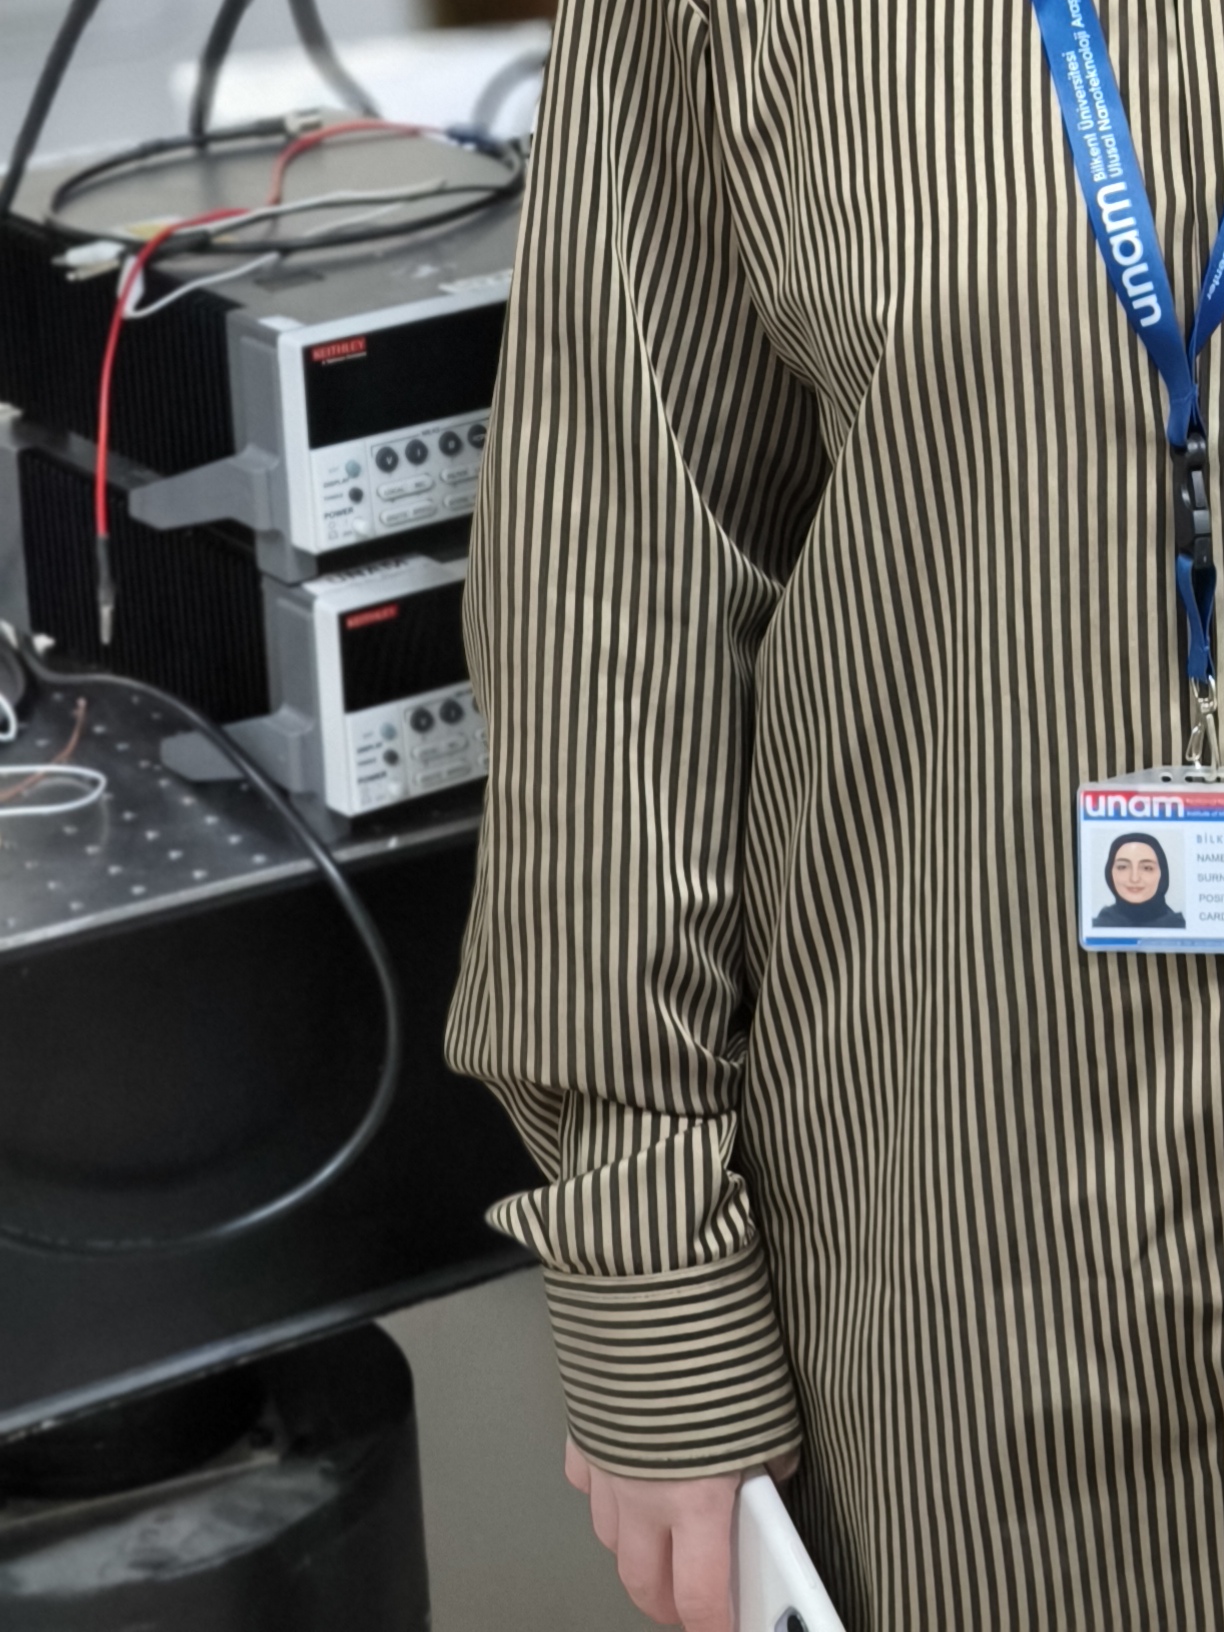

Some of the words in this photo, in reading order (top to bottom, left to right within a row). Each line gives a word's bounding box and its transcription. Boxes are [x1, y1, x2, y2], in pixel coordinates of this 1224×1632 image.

[1061, 50, 1094, 131] Üniversitesi
[1073, 30, 1112, 131] Nanoteknoloji
[1082, 132, 1107, 182] Bilkent
[1101, 133, 1123, 178] Ulusal
[1097, 181, 1161, 327] unam
[1085, 794, 1184, 818] unam
